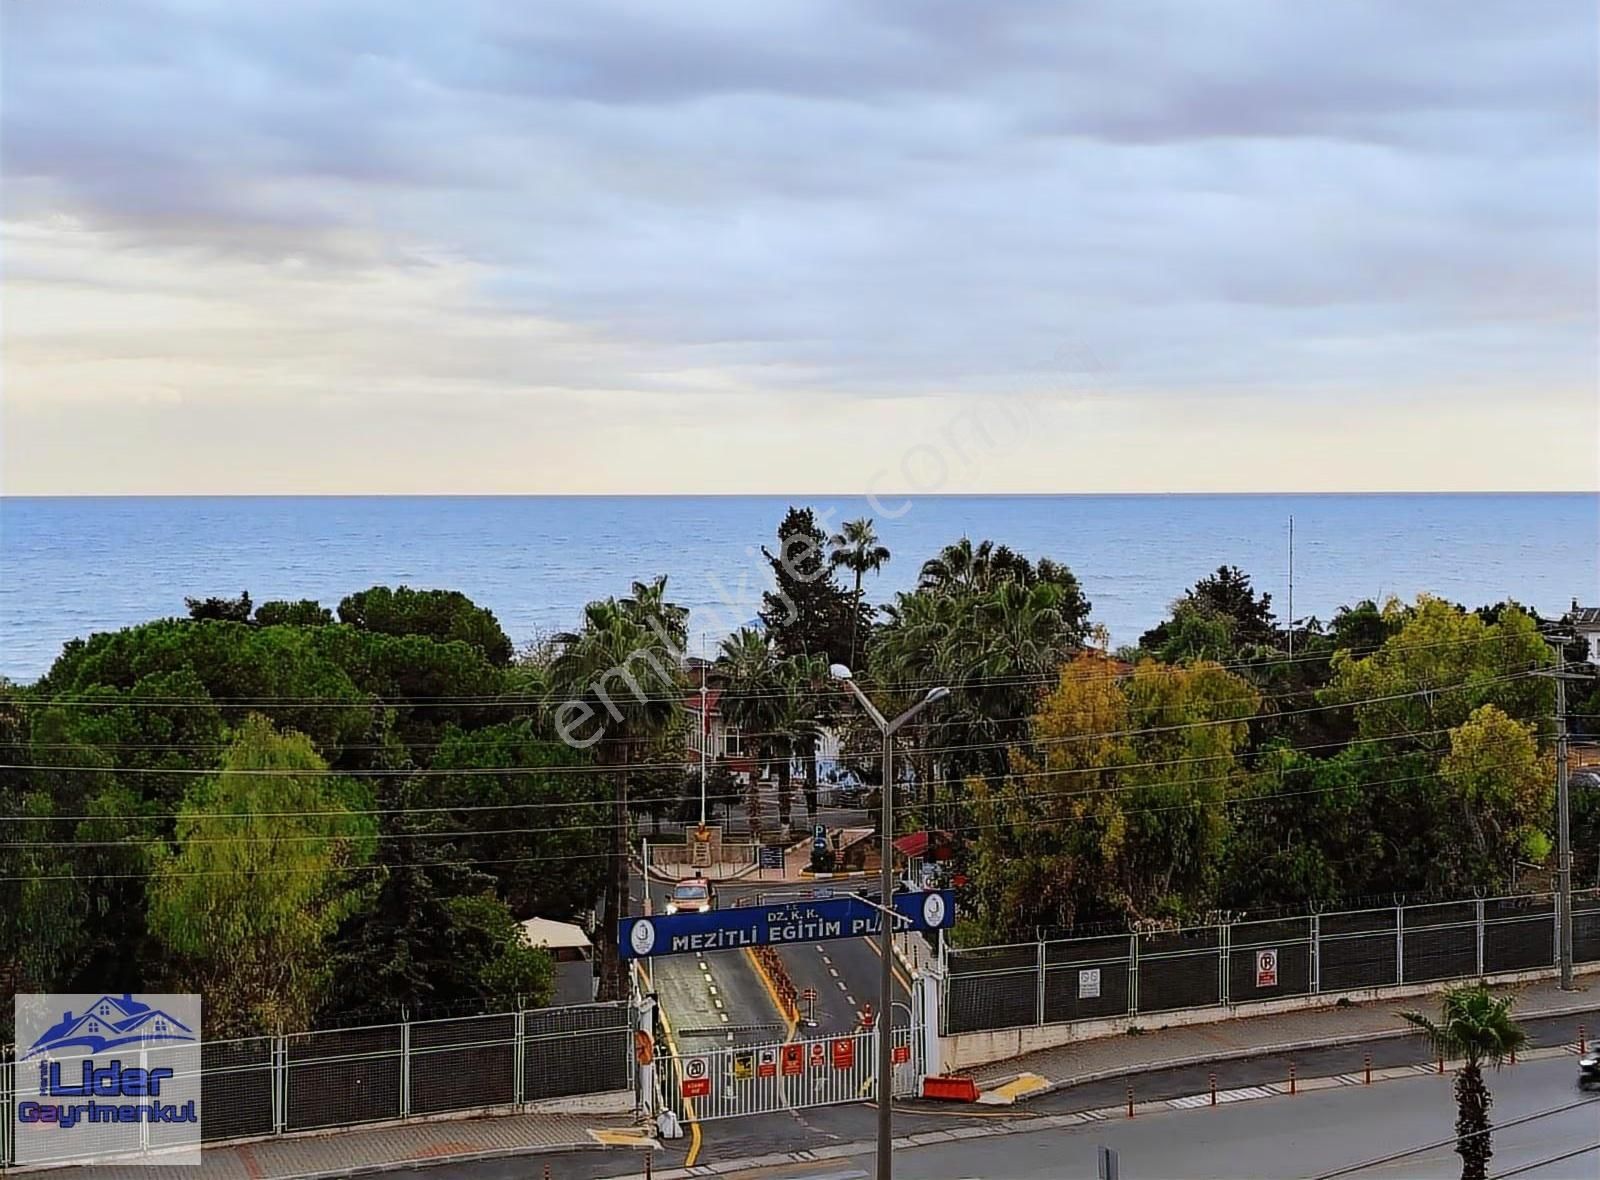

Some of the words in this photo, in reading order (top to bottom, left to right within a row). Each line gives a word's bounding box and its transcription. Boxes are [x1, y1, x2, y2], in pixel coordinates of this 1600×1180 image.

[768, 911, 788, 922] DZ.
[672, 925, 757, 951] MEZİTLİ
[769, 918, 841, 942] EĞİTİM
[852, 914, 909, 934] PLJI
[691, 1063, 702, 1075] 20
